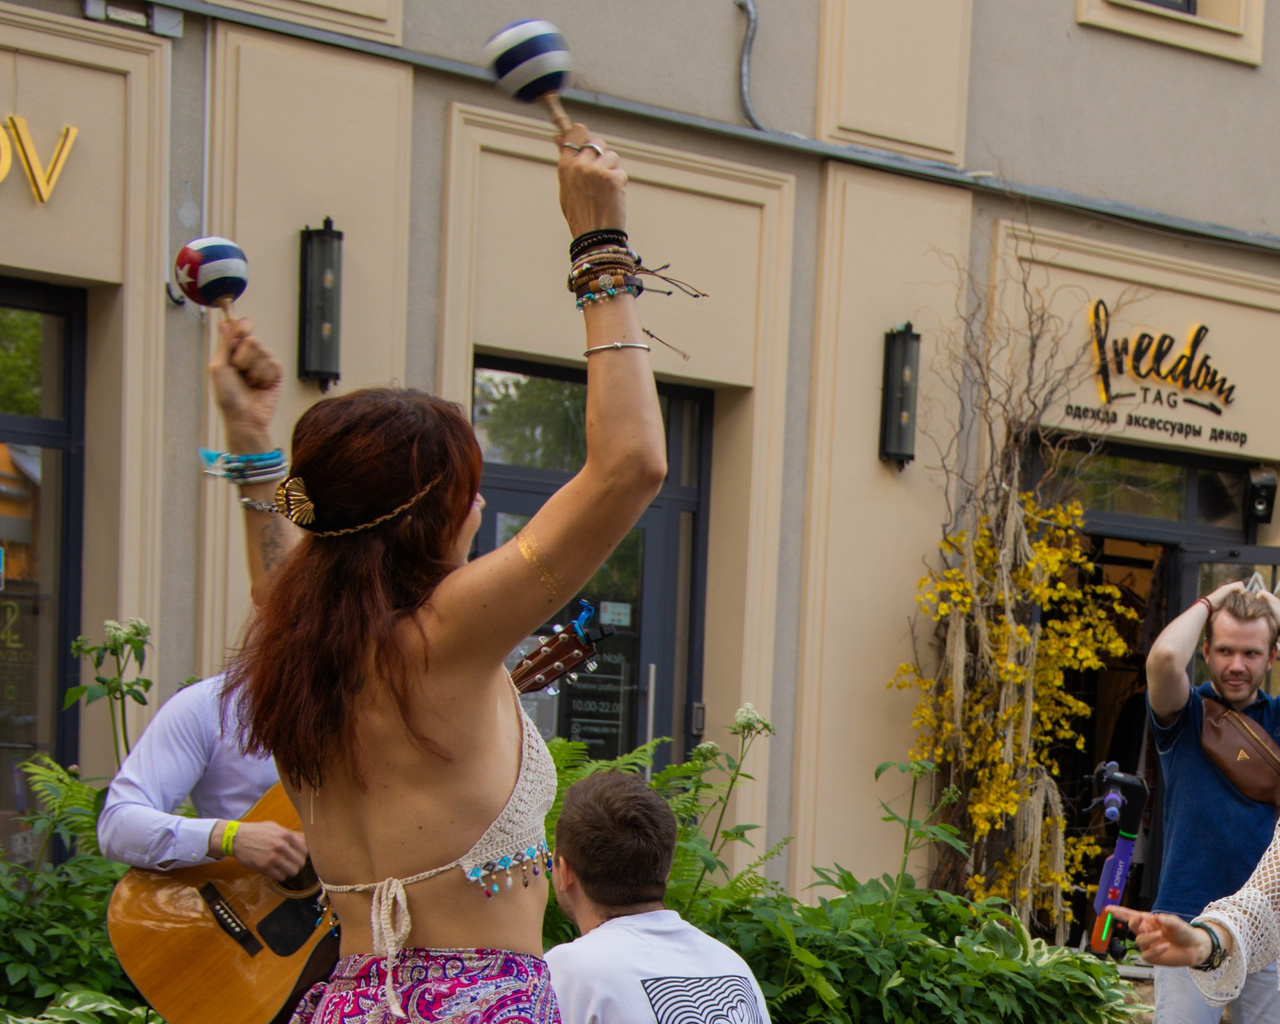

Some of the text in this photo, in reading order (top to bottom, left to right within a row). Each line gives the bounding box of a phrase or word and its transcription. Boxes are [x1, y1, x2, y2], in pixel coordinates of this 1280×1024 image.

[1140, 387, 1178, 408] TAG
[1065, 403, 1247, 446] одежда аксессуары декор
